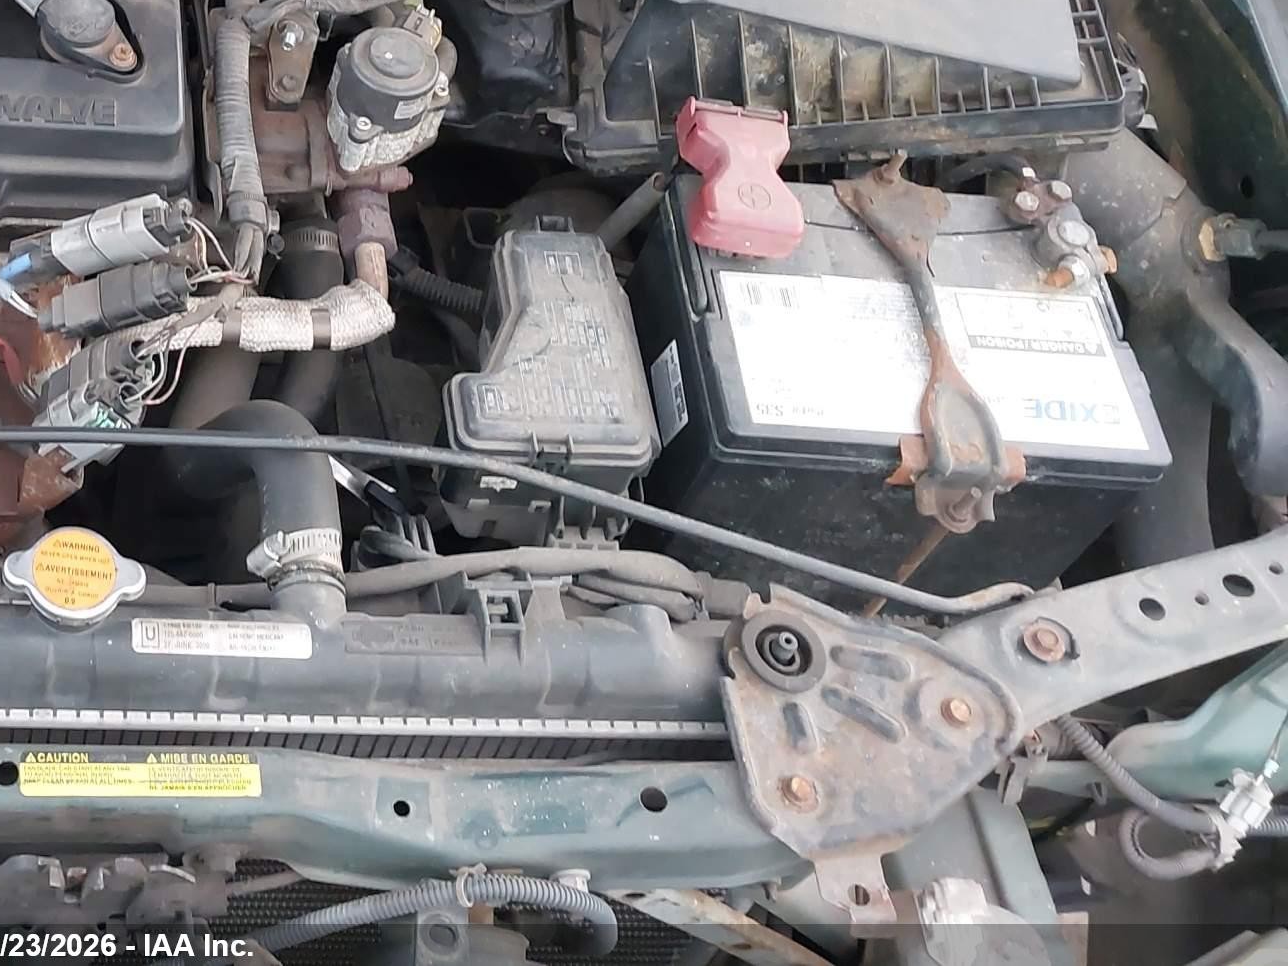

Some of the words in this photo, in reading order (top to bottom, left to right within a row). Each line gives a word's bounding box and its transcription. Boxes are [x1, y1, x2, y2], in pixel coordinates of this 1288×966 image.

[1023, 398, 1121, 425] EXIDE
[62, 541, 100, 553] WARNING
[46, 564, 112, 580] AVERTISSEMENT
[37, 752, 89, 763] CAUTION
[160, 753, 188, 763] MISE
[192, 753, 207, 763] EN
[210, 753, 250, 764] GARDE
